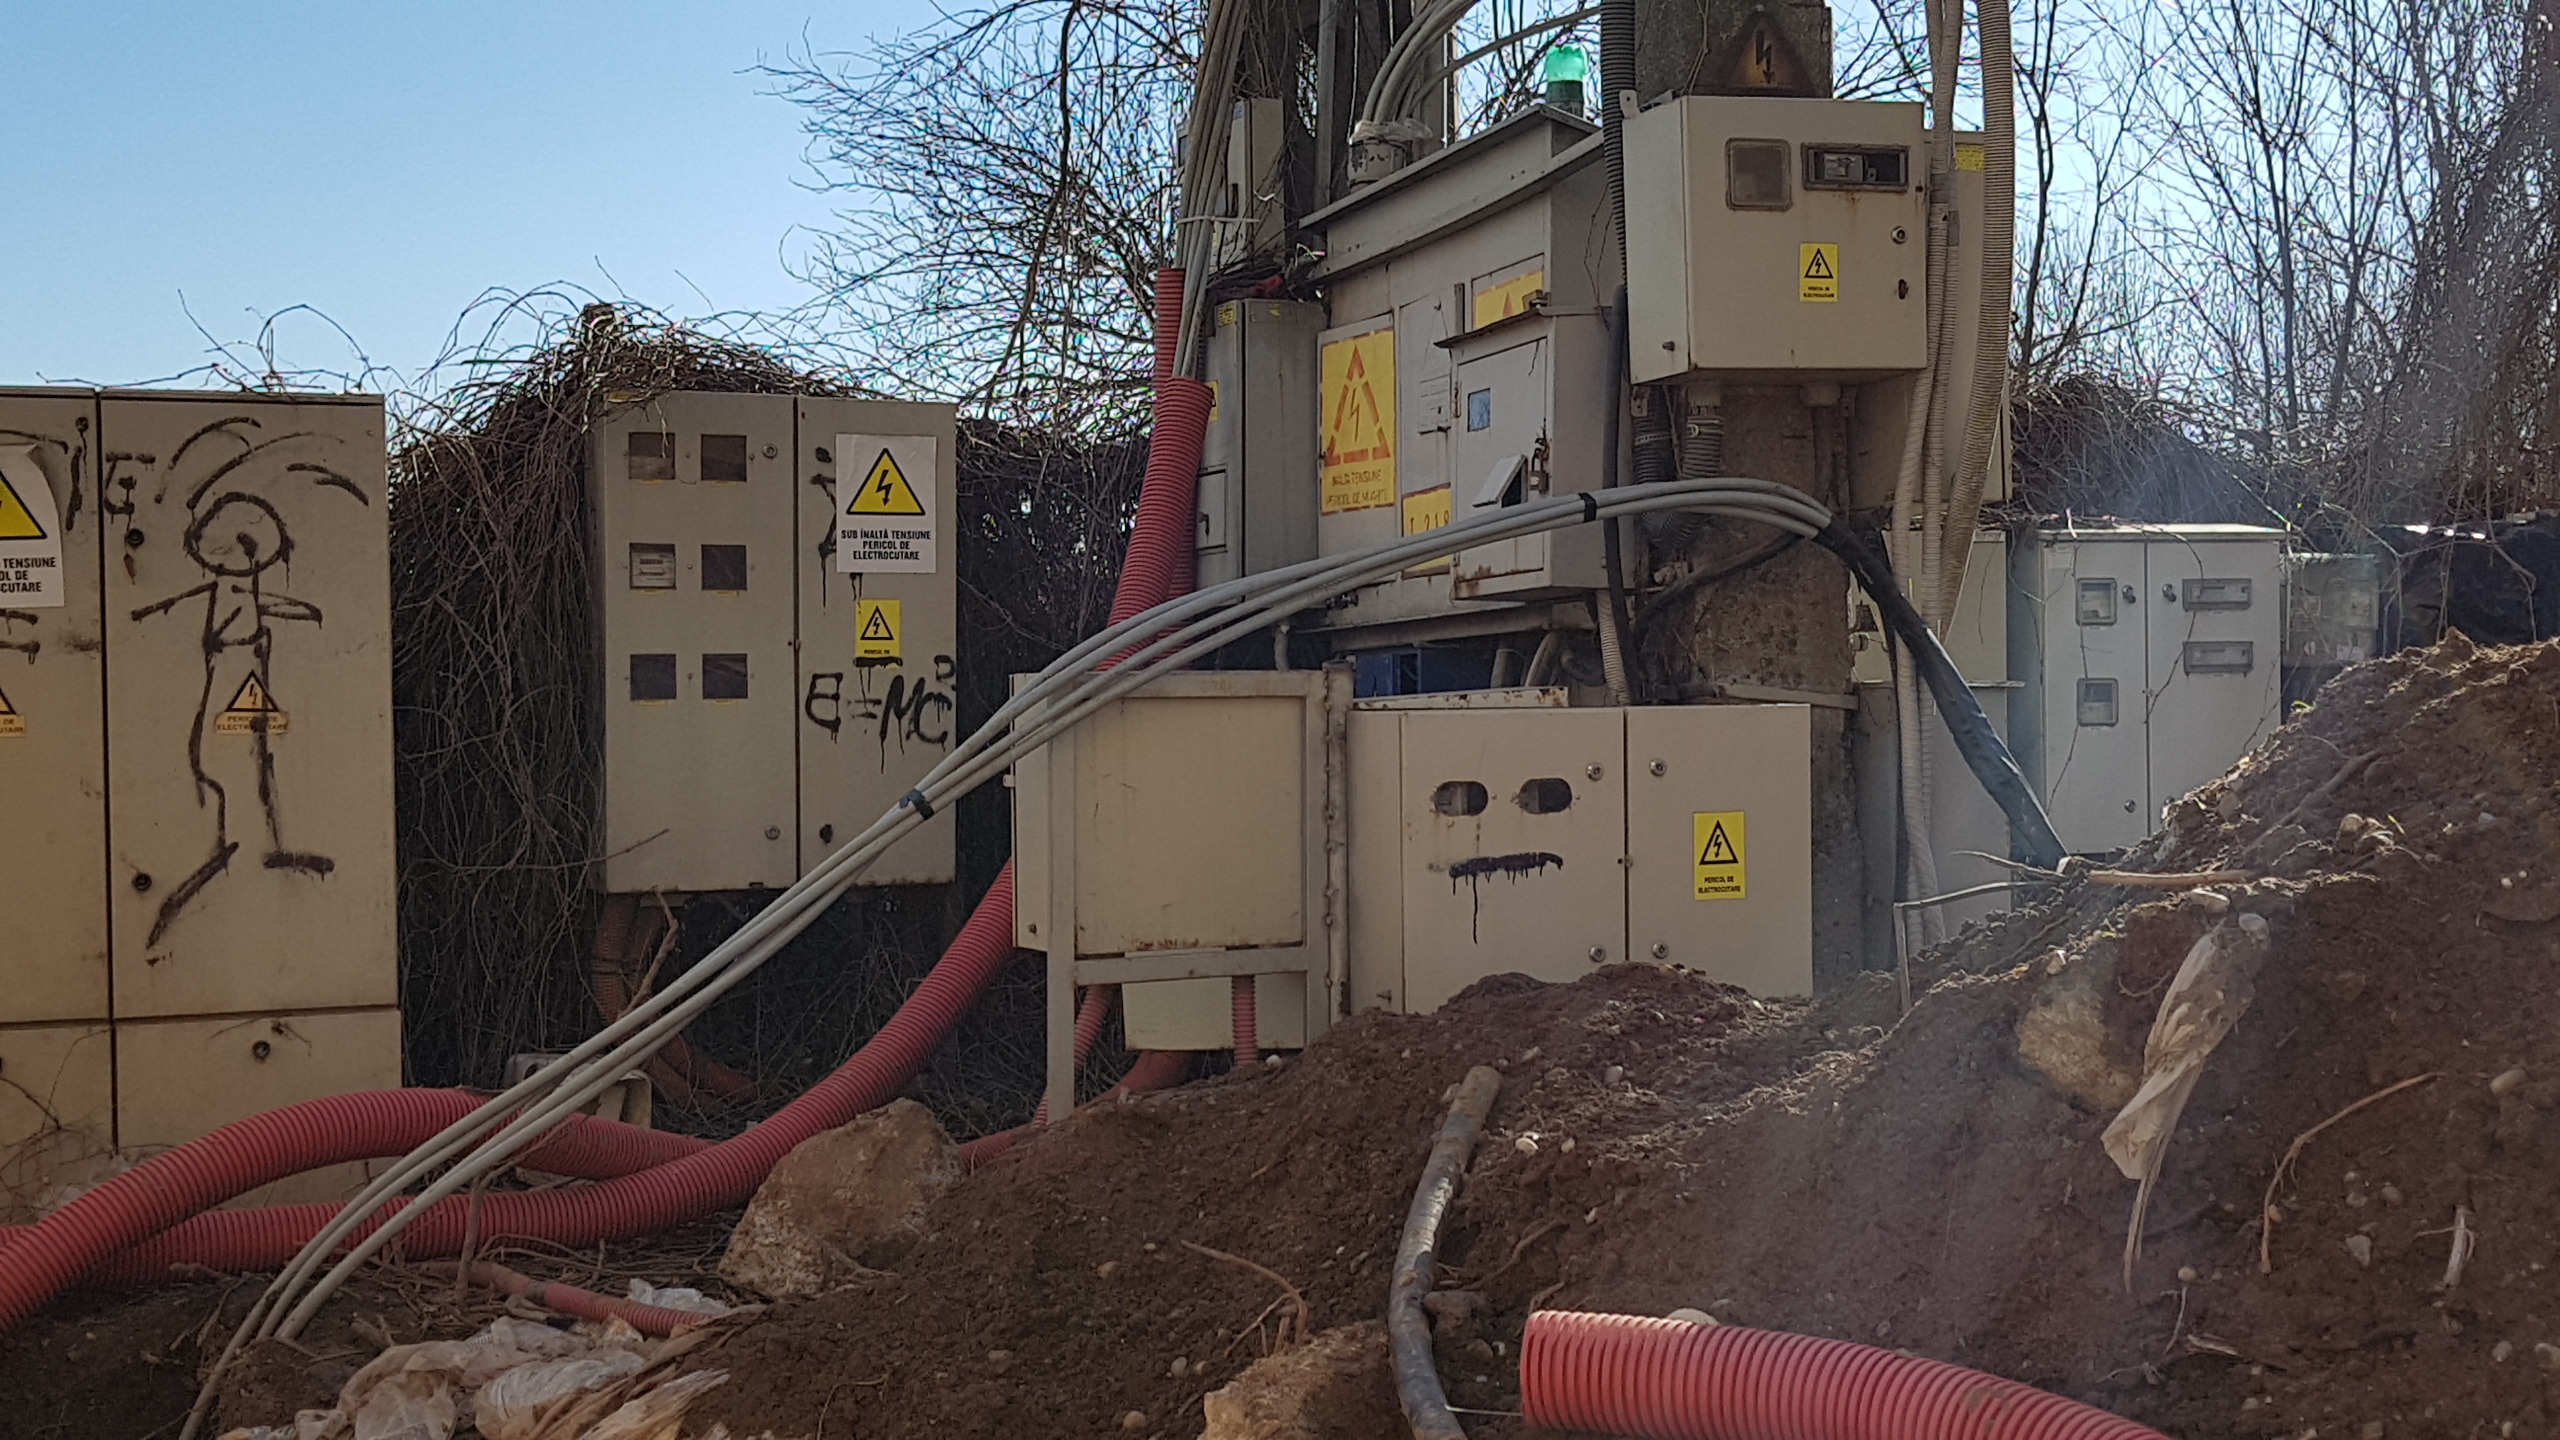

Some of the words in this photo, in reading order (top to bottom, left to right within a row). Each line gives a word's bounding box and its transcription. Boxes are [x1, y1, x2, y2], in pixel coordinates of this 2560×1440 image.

[841, 529, 858, 539] SUB
[891, 530, 932, 540] TENSIUNE
[863, 540, 898, 550] PERICOL
[899, 540, 911, 549] DE
[853, 550, 920, 561] ELECTROCUTARE
[3, 556, 56, 569] TENSIUNE
[15, 570, 28, 580] DE
[1, 581, 42, 593] CUTARE
[217, 723, 288, 731] ELECTRTARE
